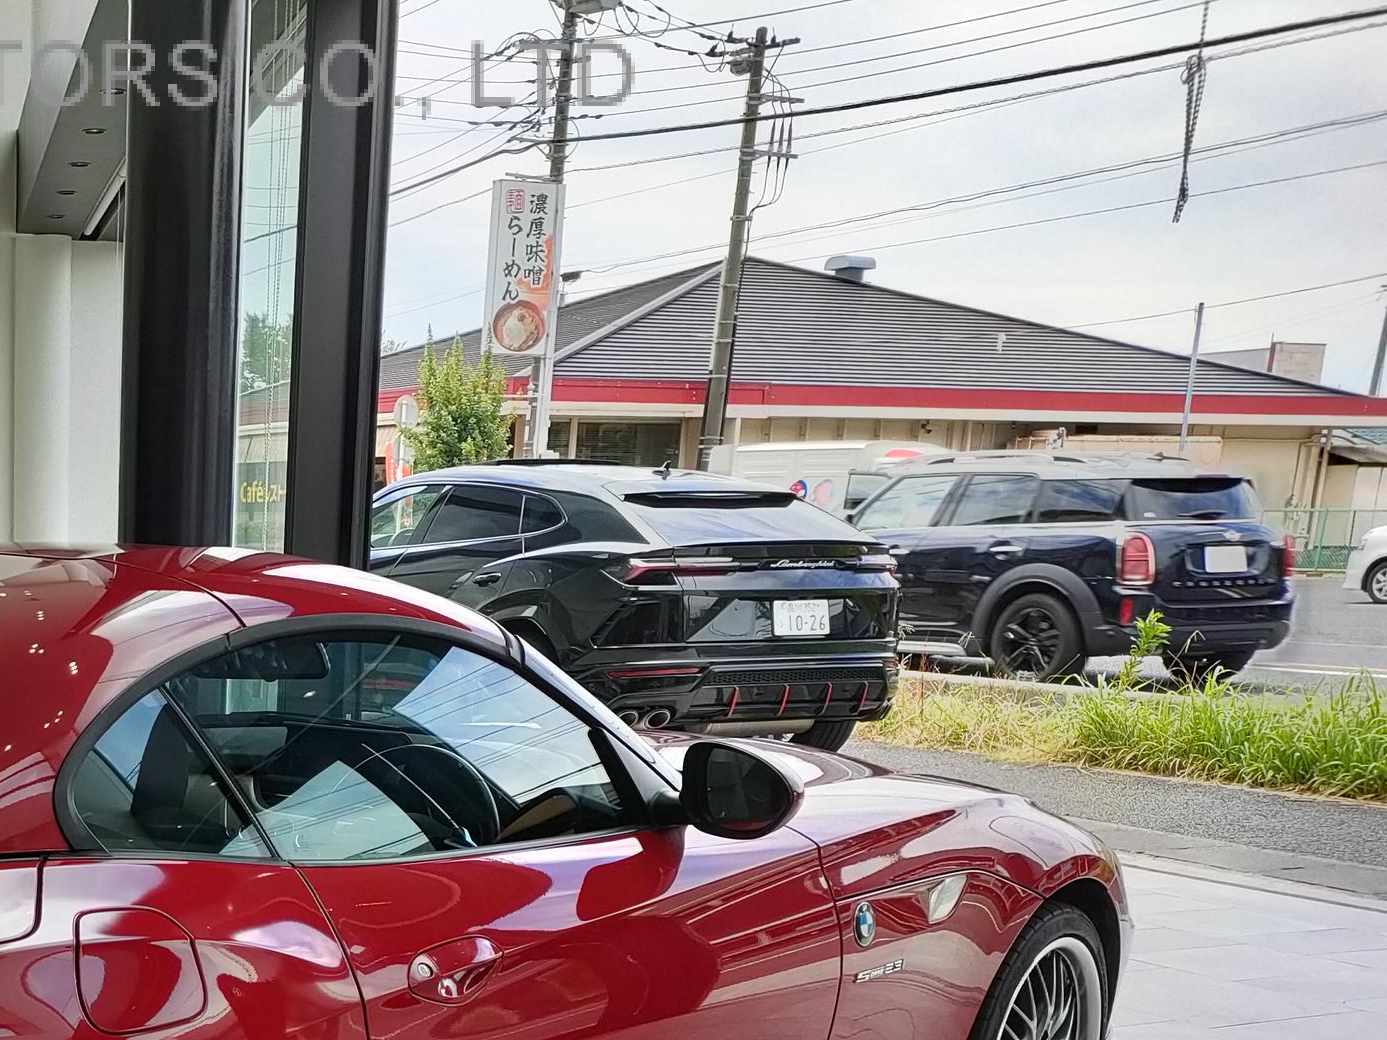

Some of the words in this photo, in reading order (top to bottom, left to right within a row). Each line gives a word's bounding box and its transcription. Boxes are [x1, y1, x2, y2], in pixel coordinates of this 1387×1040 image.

[502, 215, 524, 301] らーめん
[524, 193, 549, 286] 濃厚味噌
[788, 614, 826, 631] 10-26
